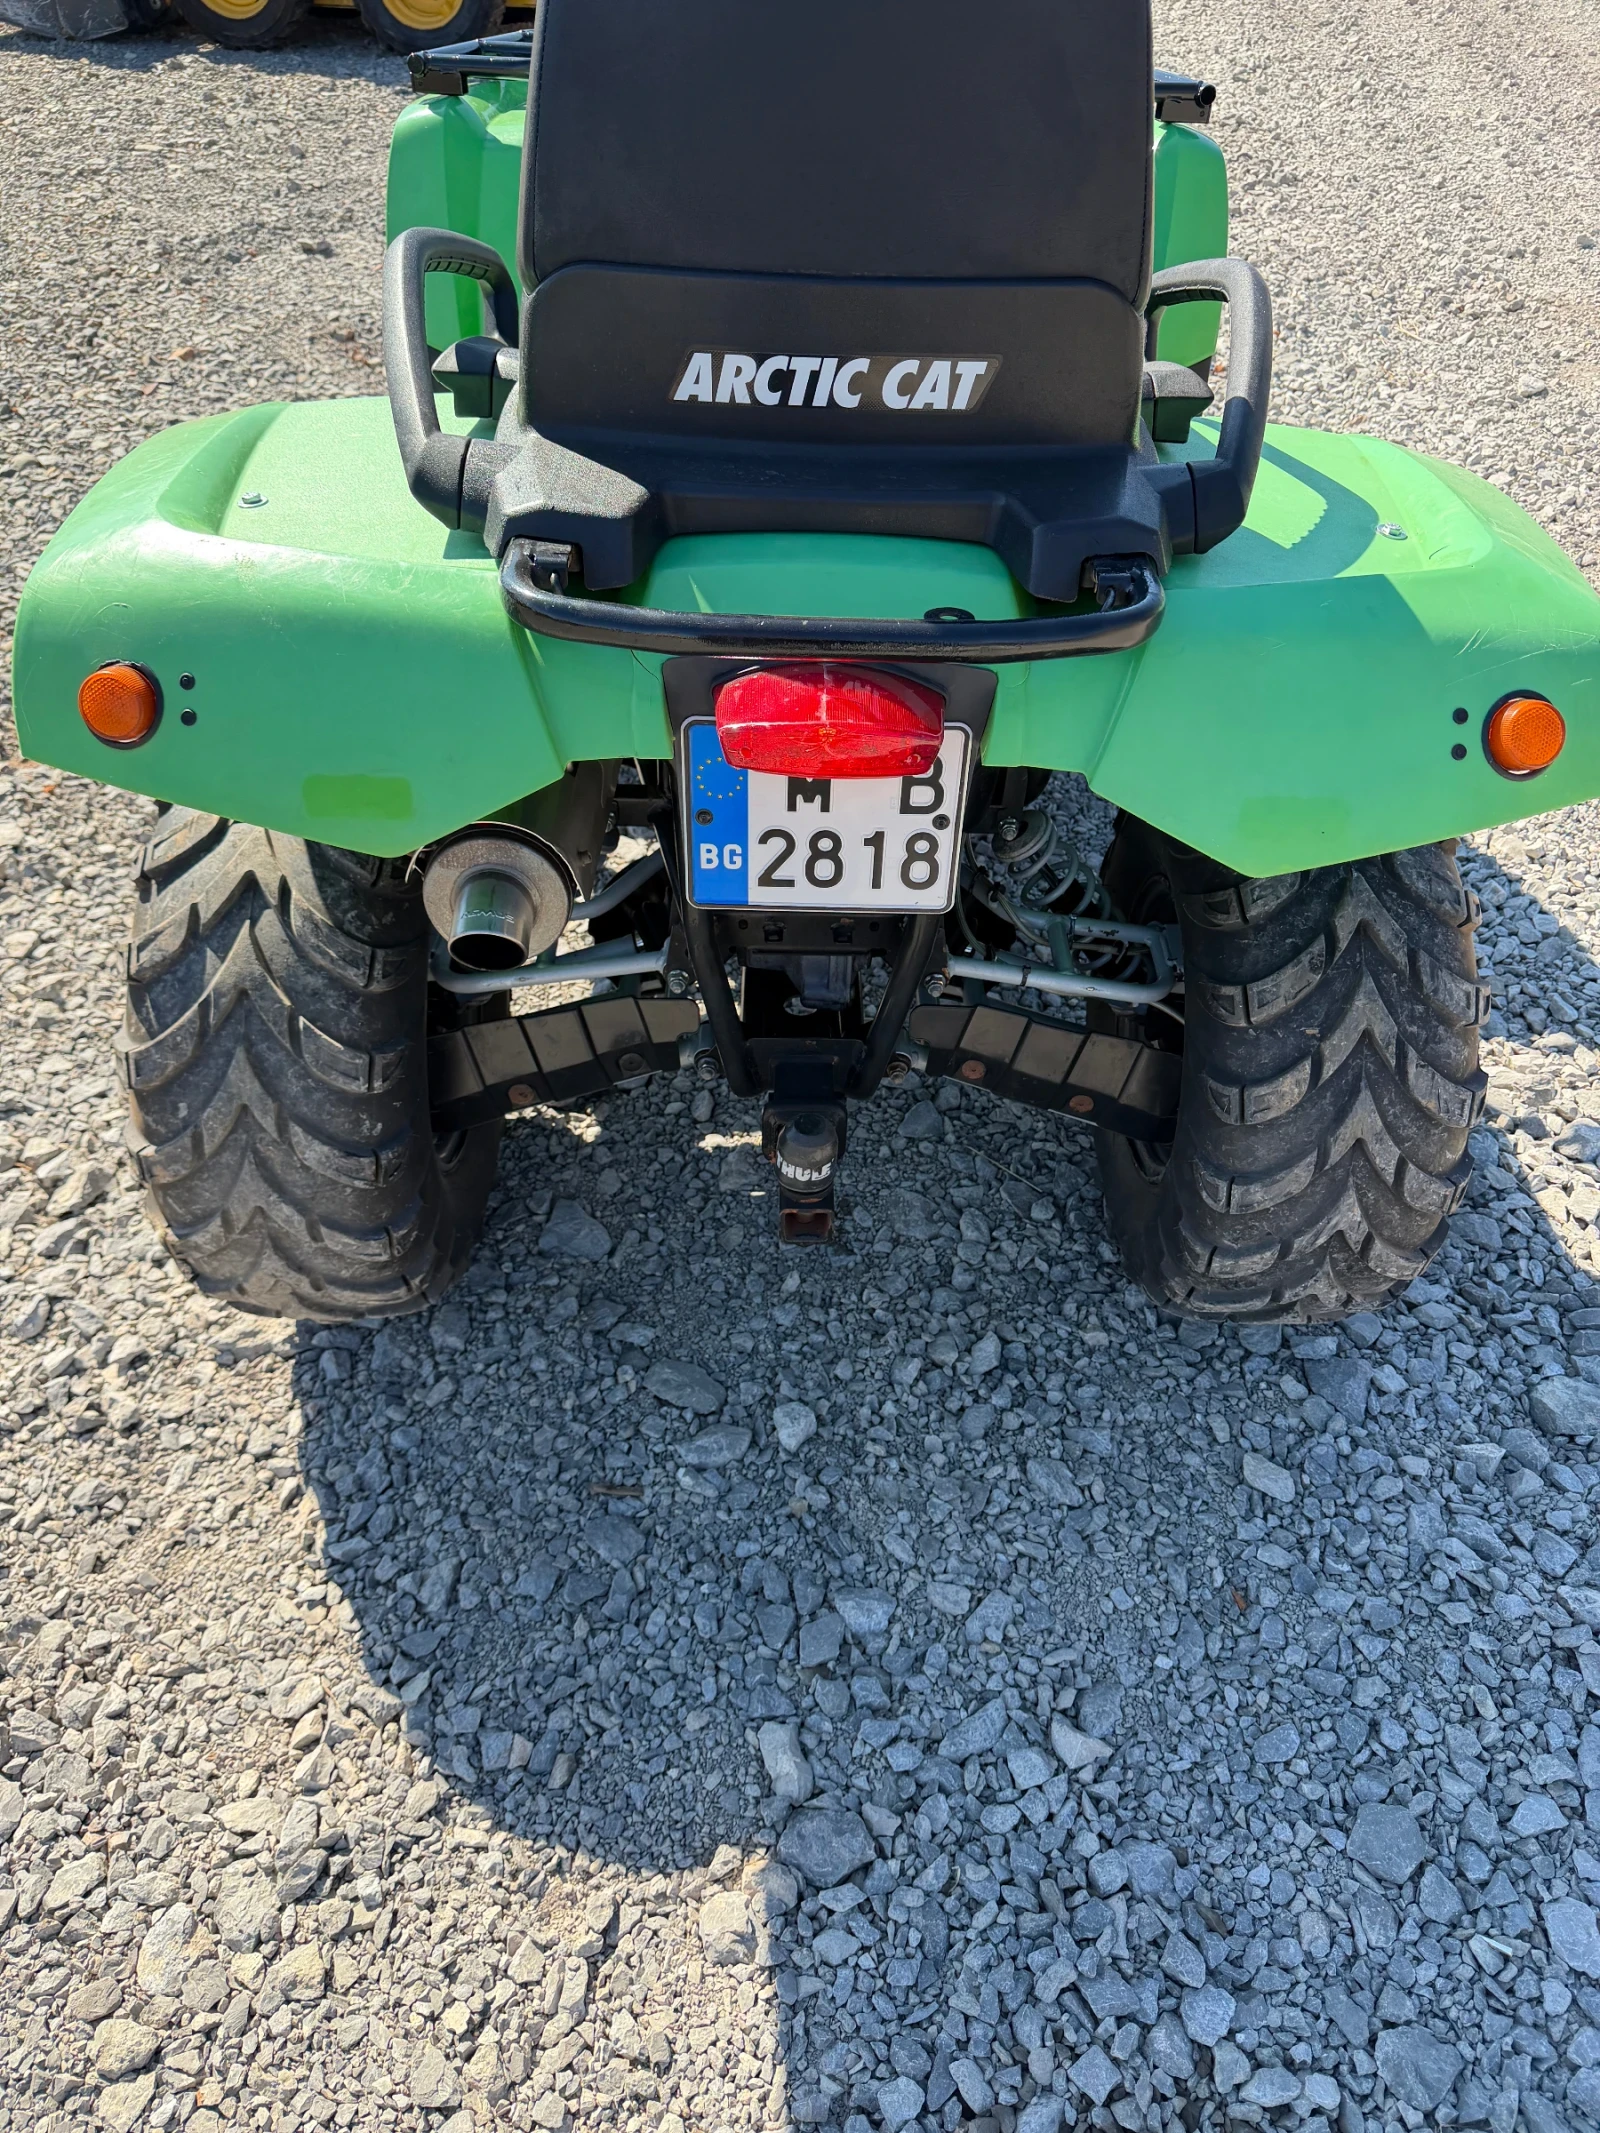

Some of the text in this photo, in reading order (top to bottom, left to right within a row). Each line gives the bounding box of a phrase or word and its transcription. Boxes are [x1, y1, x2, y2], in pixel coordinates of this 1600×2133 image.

[673, 352, 988, 410] ARCTIC CAT
[899, 755, 945, 815] B
[700, 843, 743, 870] BG
[757, 828, 941, 891] 2818
